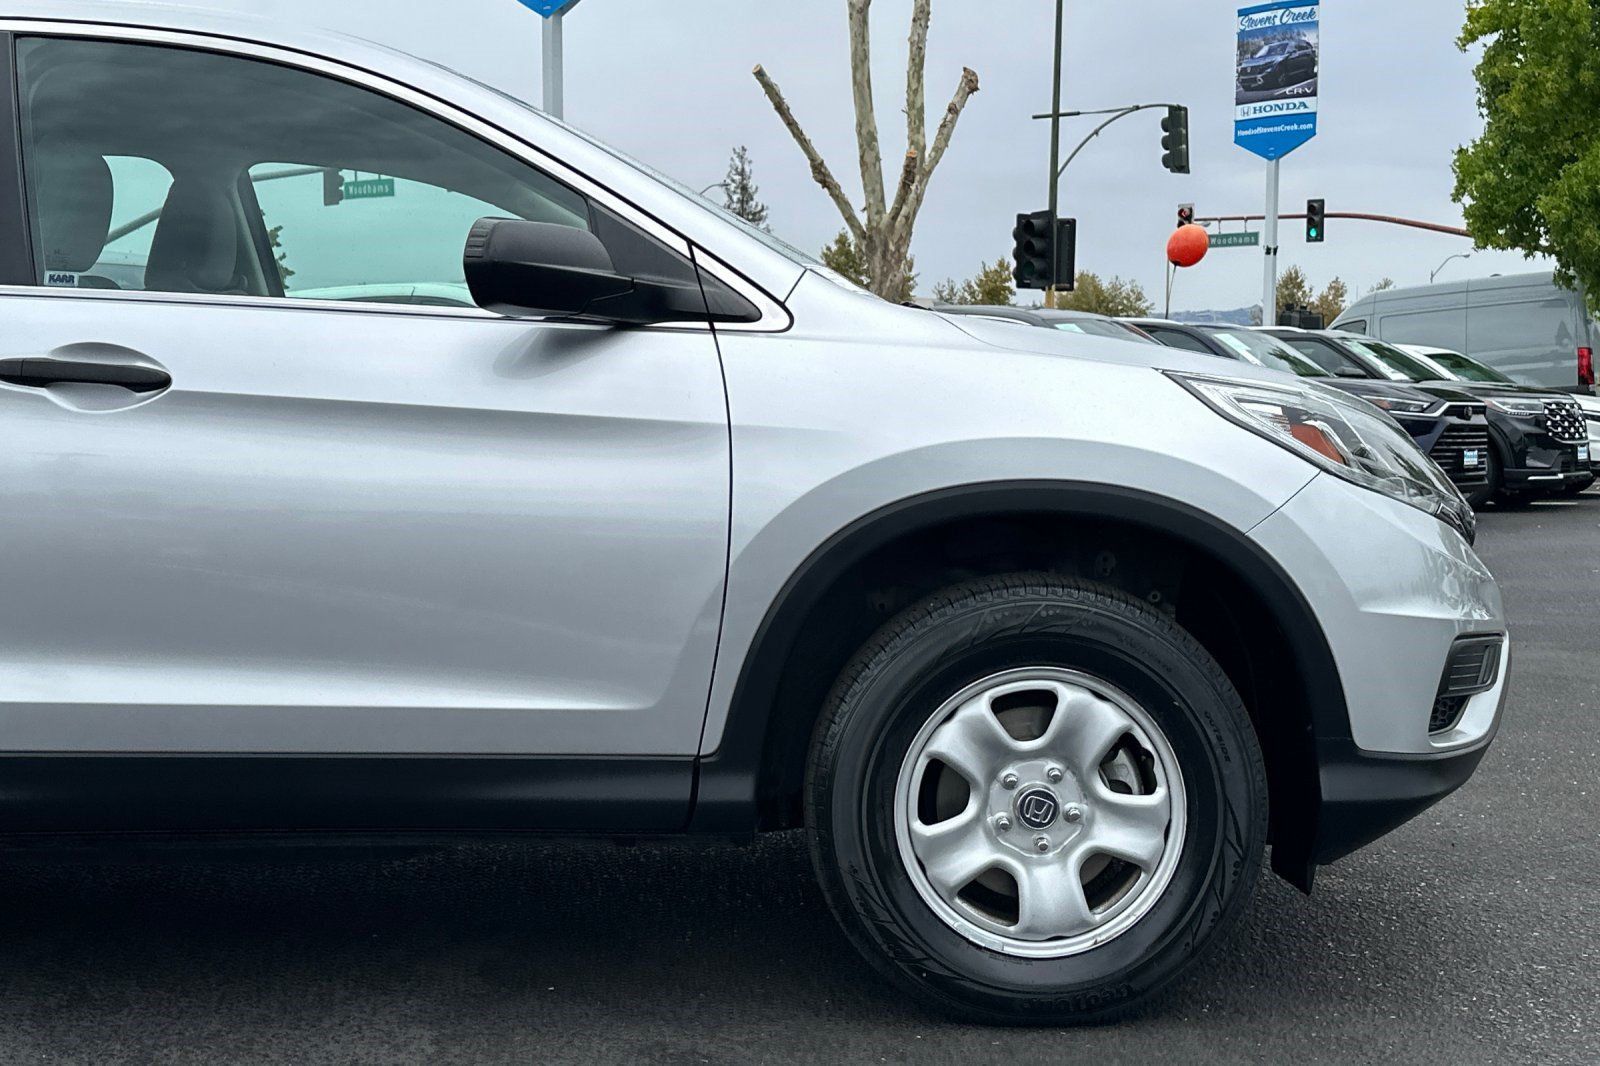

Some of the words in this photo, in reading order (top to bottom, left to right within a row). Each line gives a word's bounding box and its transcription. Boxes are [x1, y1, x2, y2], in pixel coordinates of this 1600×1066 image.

[1239, 13, 1277, 31] Stevens
[1279, 7, 1317, 25] Creek
[1253, 101, 1309, 114] HONDA
[1210, 235, 1256, 245] Woodhams
[48, 273, 75, 284] KARR
[1204, 711, 1231, 762] OUTSIDE
